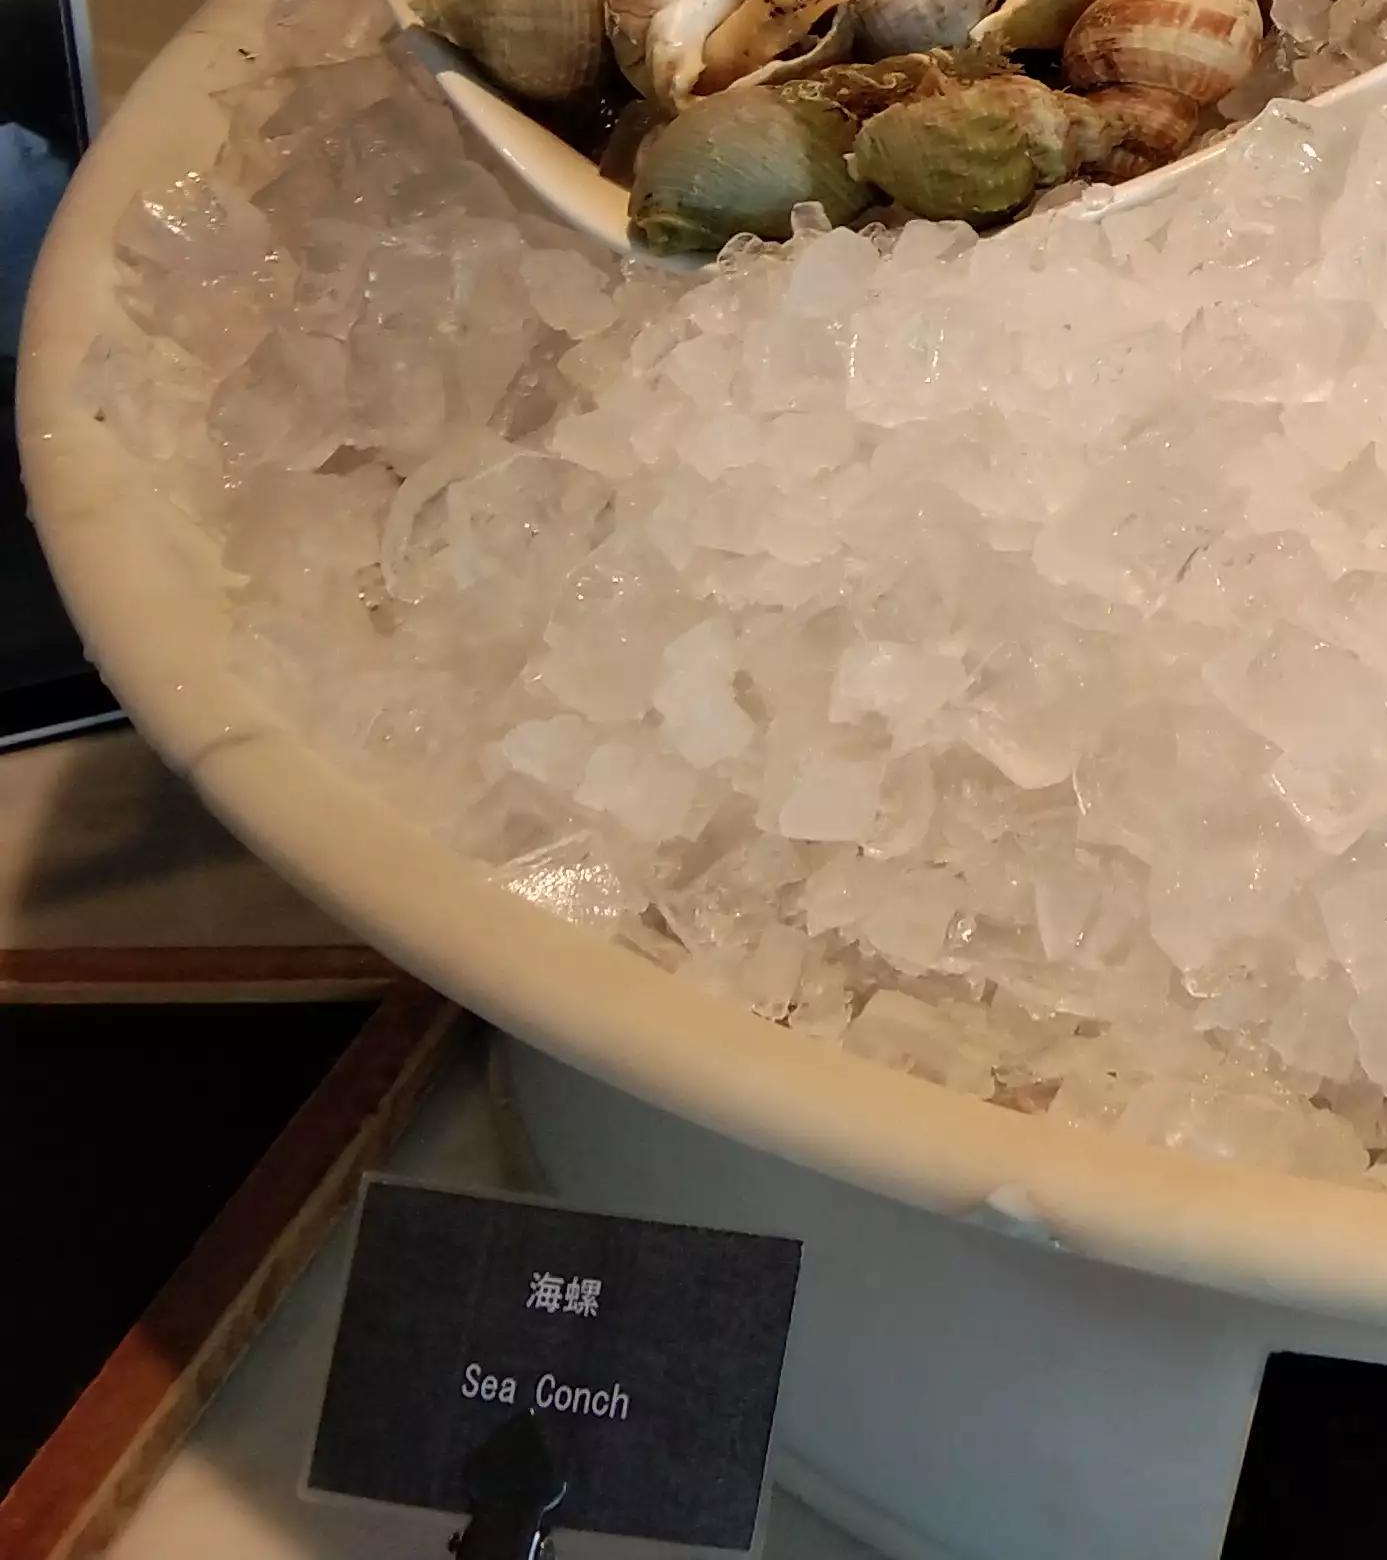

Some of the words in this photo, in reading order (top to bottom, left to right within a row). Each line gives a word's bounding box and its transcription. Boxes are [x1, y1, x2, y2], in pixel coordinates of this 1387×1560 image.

[525, 1271, 602, 1317] 海螺
[462, 1362, 516, 1404] Sea
[536, 1373, 630, 1419] Conch
